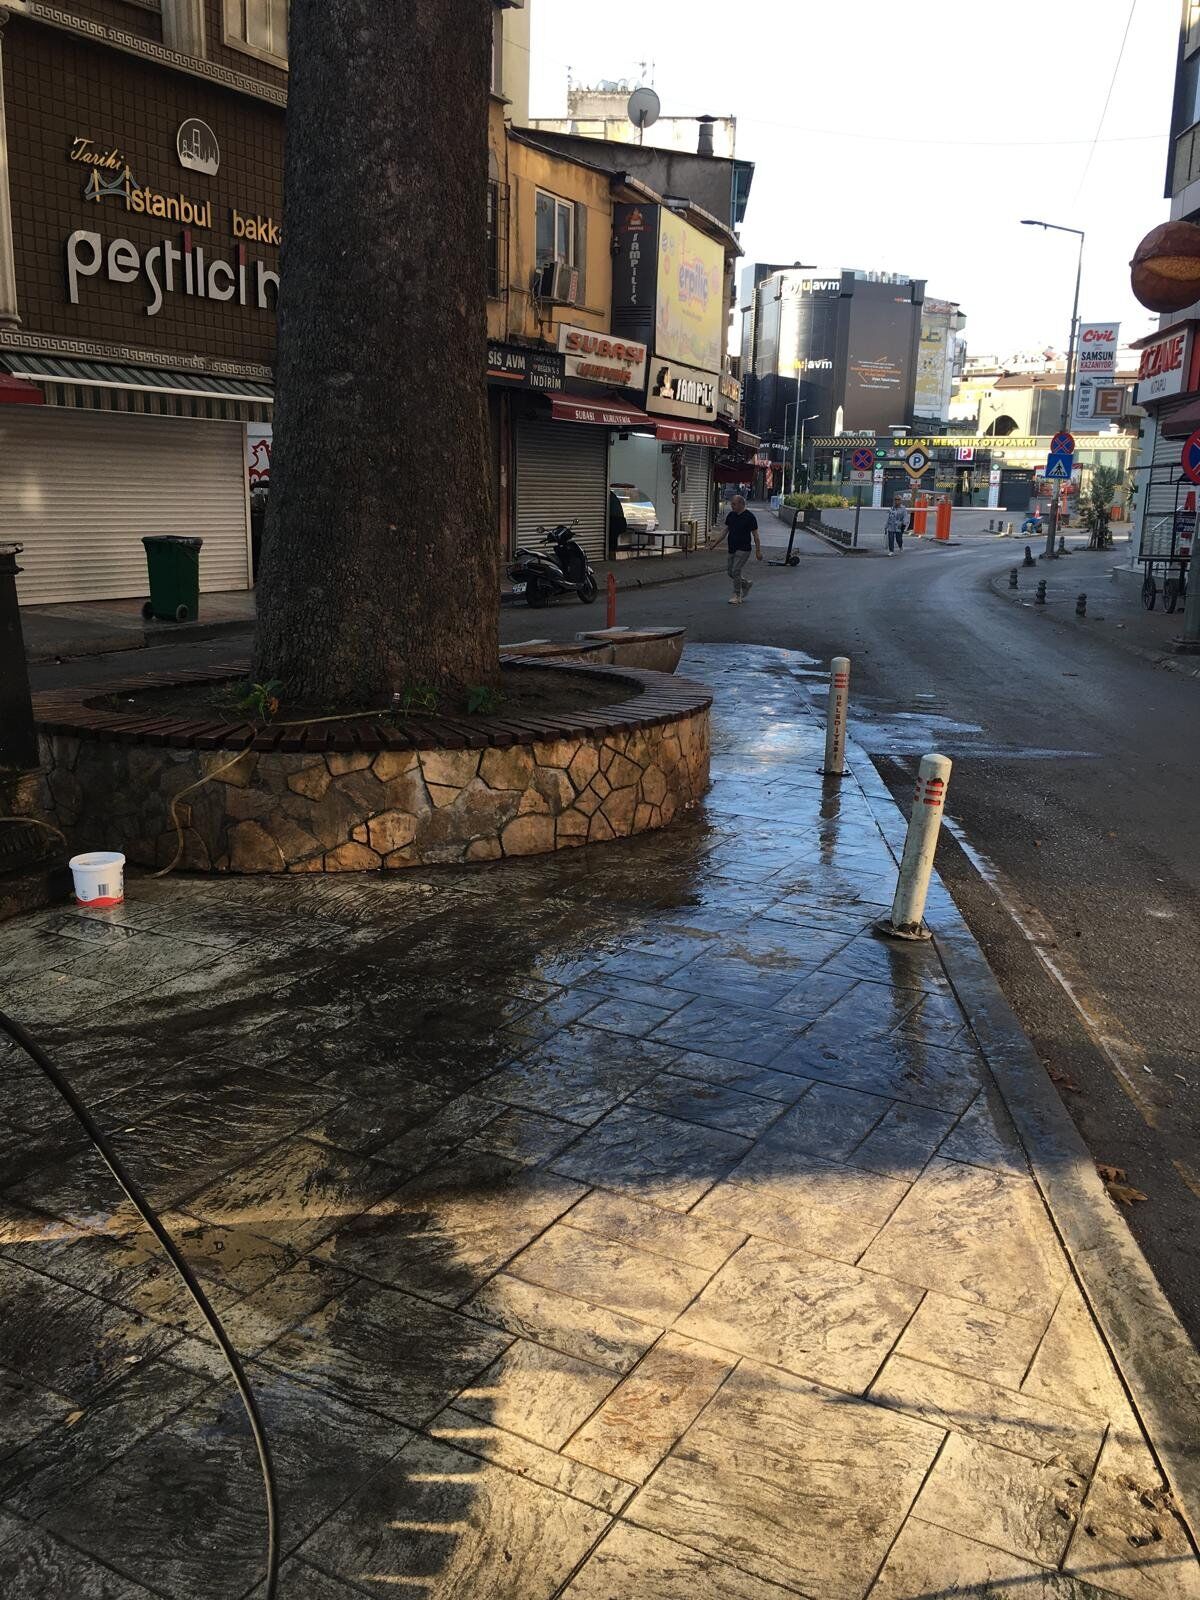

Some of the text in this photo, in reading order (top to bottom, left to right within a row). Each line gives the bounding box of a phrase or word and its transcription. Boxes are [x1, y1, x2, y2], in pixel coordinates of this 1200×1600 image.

[71, 136, 125, 171] Tarihi
[505, 353, 526, 371] AVM
[1081, 351, 1114, 361] SAMSUN
[1101, 392, 1118, 412] E
